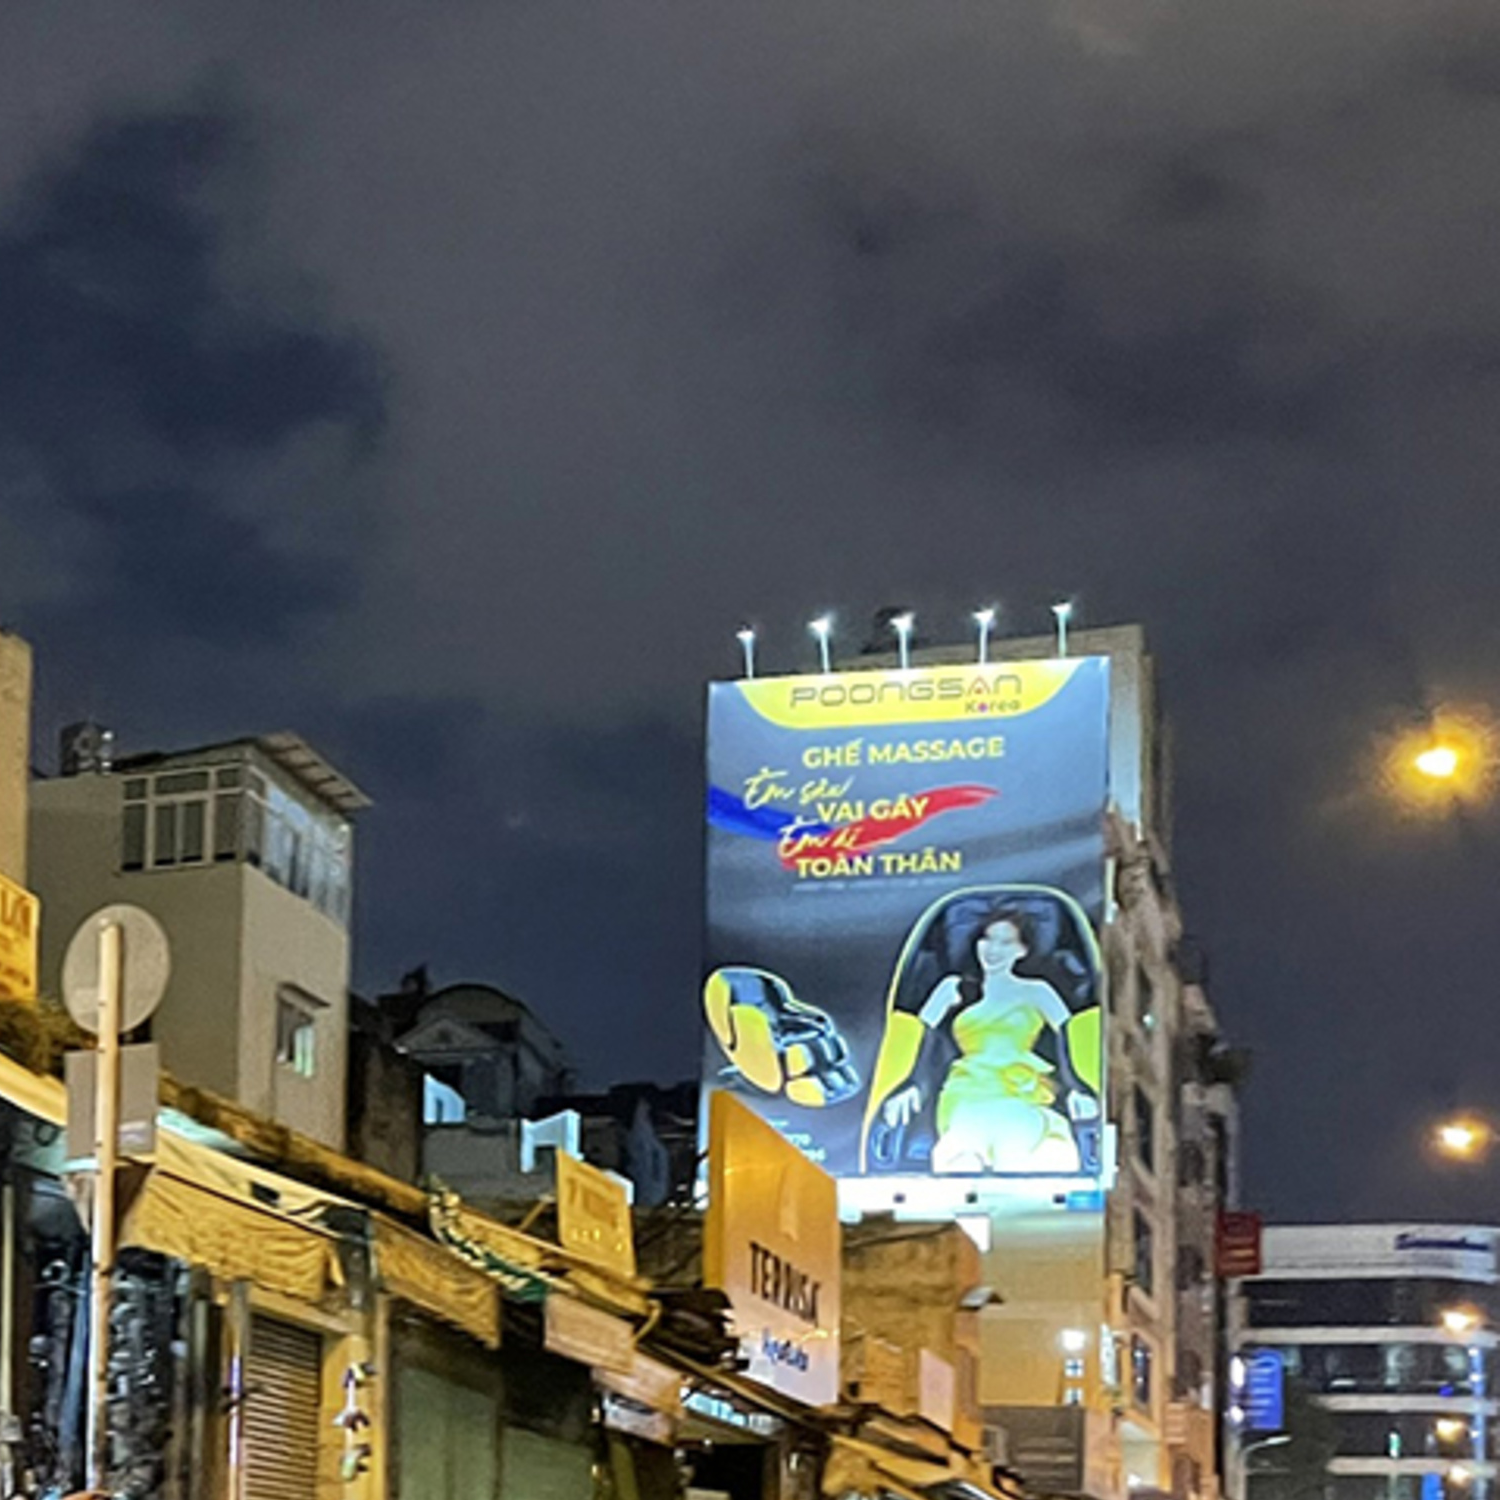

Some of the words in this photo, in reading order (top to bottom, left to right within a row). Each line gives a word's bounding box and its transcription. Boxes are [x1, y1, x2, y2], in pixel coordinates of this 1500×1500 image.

[803, 738, 864, 769] GHẾ
[868, 737, 1005, 765] MASSAGE
[816, 801, 864, 823] VAI
[796, 850, 873, 878] TOÀN
